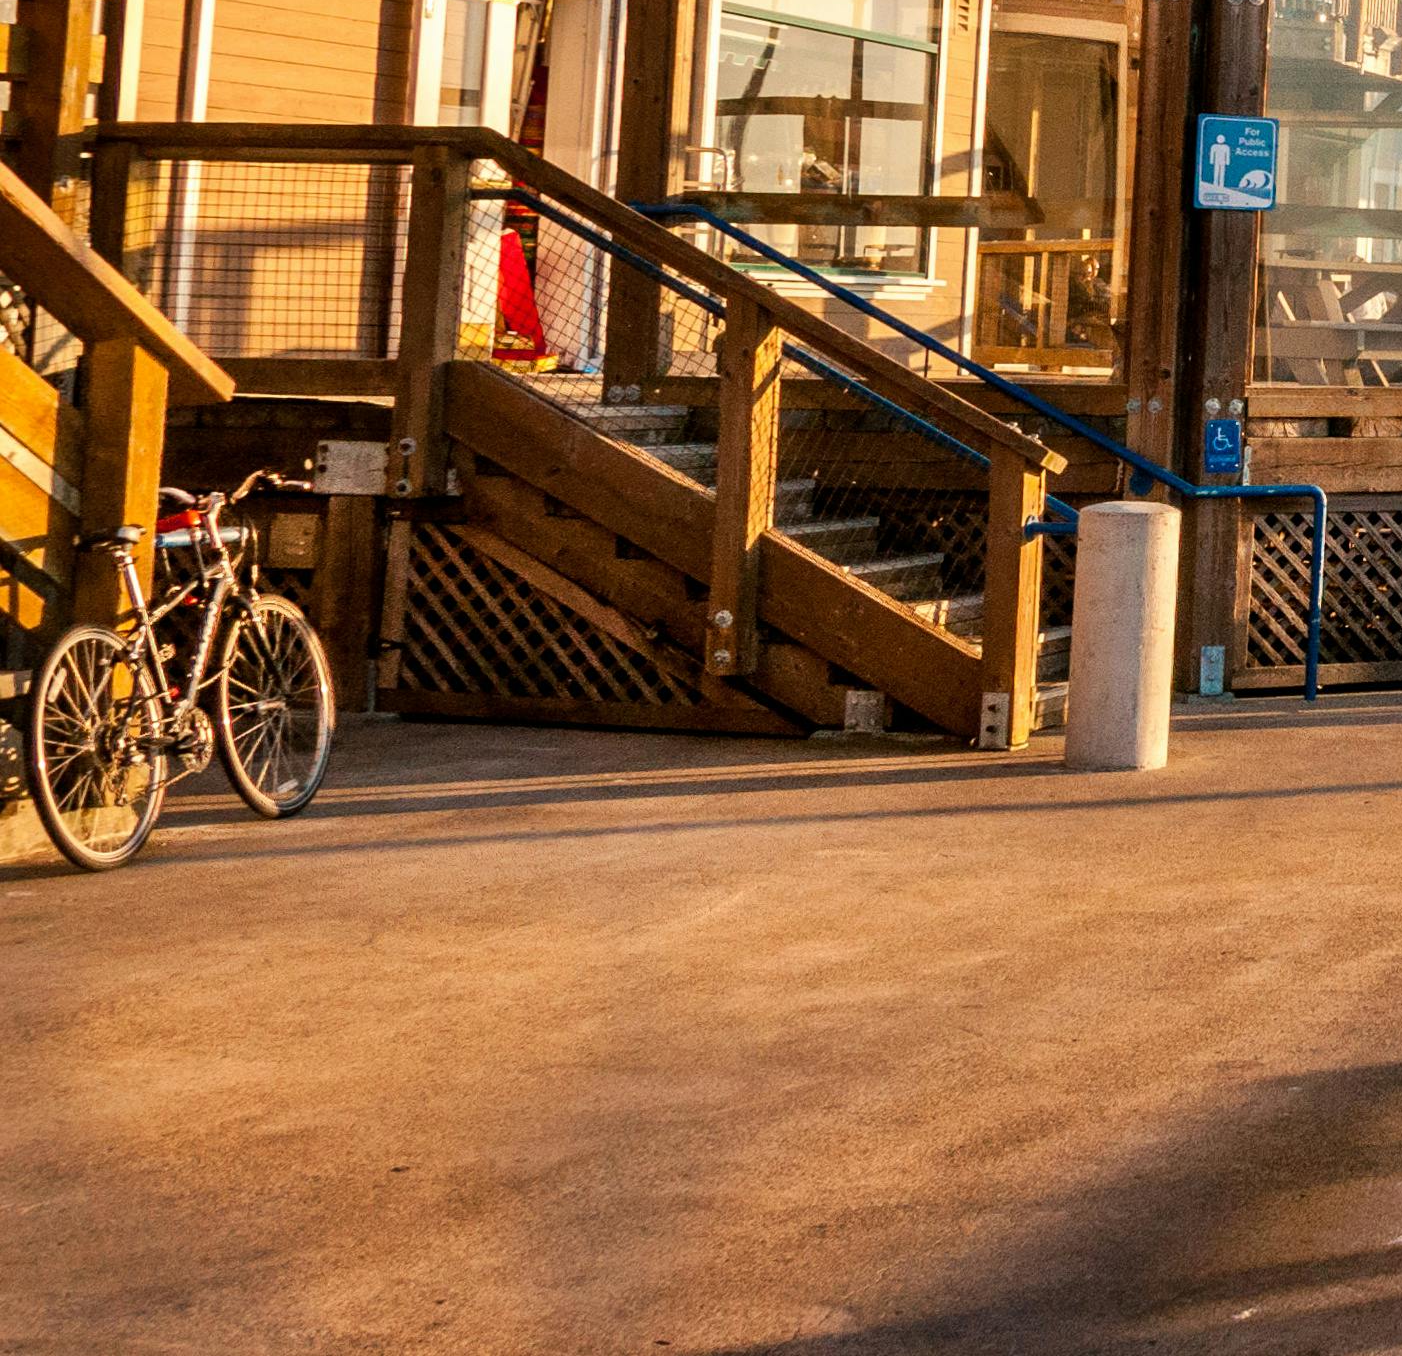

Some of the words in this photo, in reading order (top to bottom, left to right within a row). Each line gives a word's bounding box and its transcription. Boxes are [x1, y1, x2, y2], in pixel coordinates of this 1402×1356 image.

[1244, 127, 1260, 136] For
[1238, 136, 1266, 146] Public
[1234, 147, 1270, 157] Access
